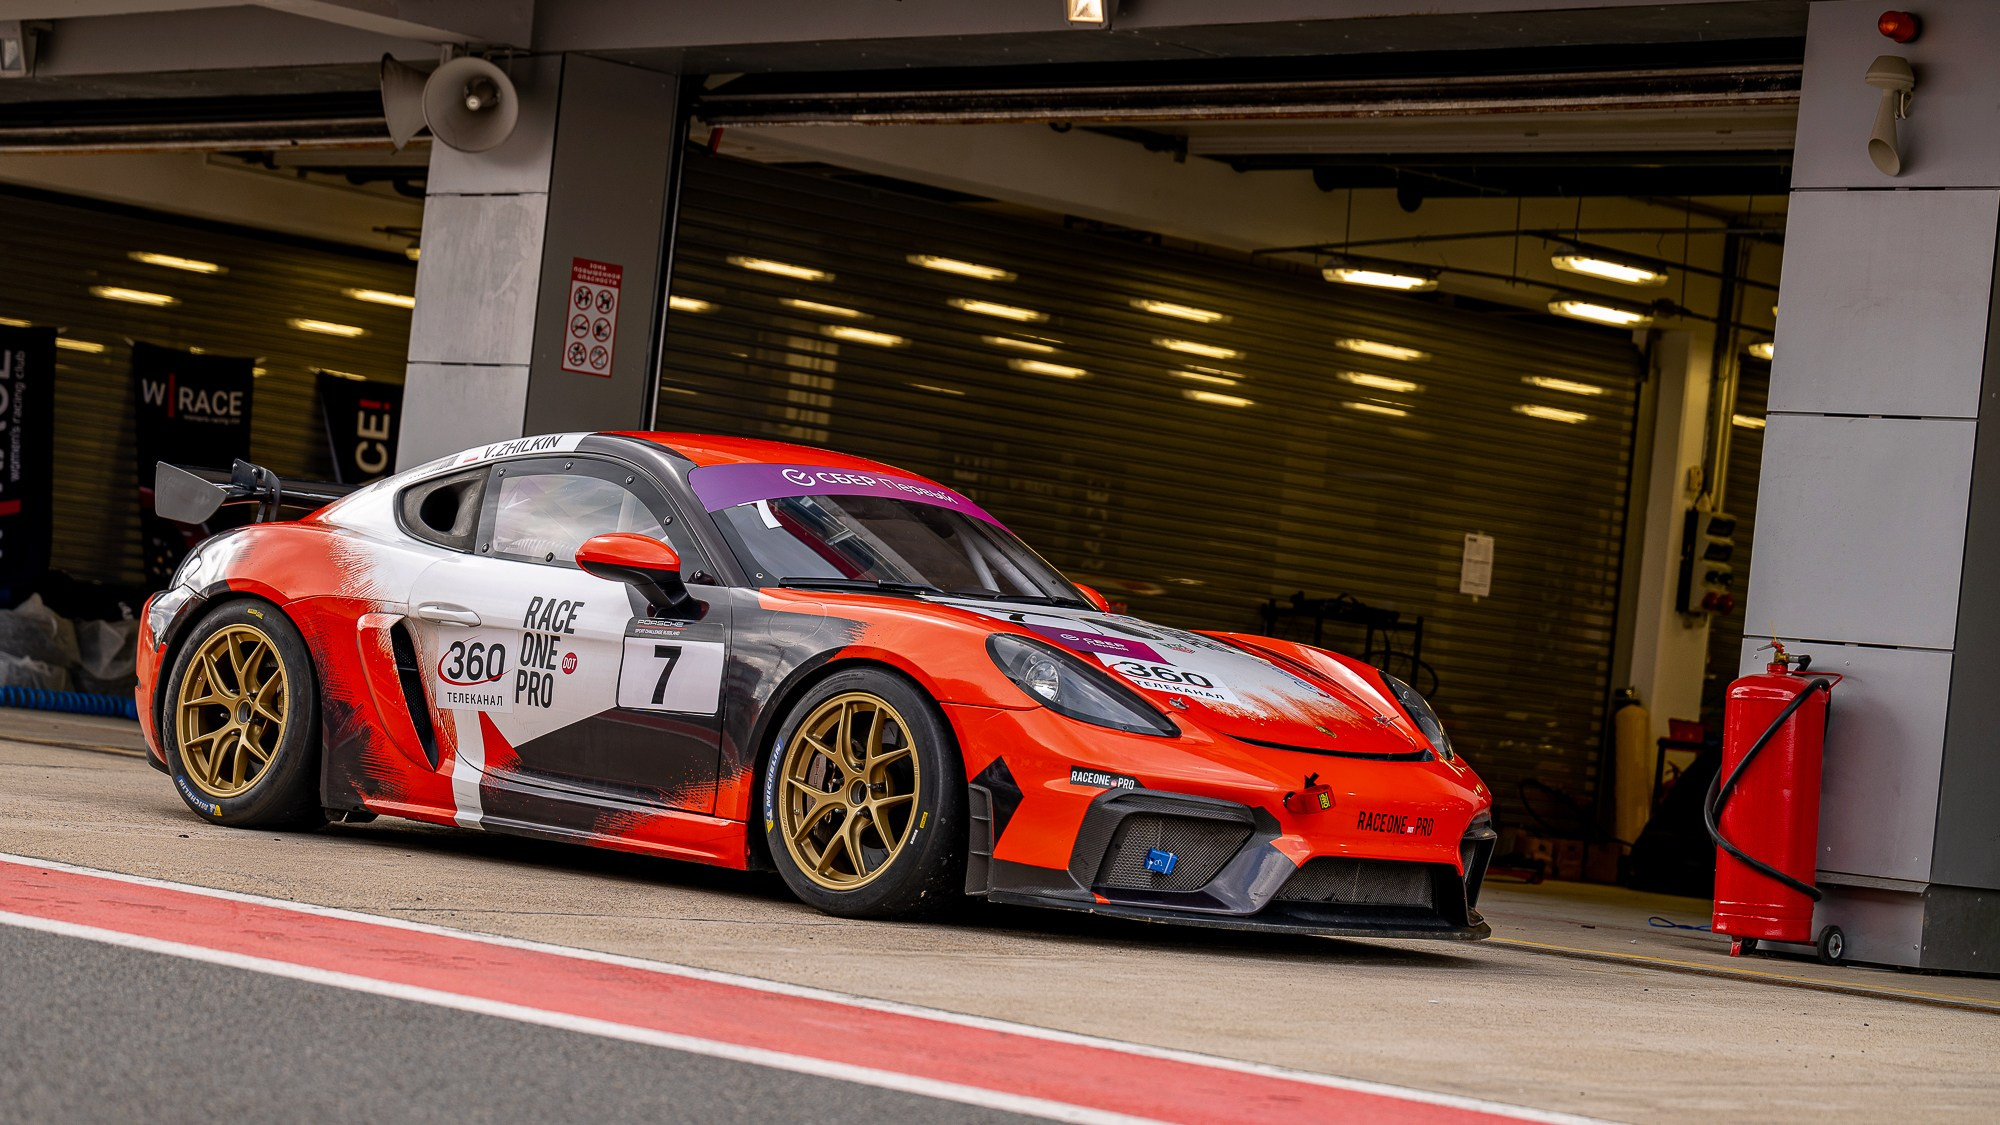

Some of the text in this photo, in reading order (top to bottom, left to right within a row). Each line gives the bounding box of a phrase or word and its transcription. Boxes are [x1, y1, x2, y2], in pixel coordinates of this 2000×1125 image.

[178, 386, 243, 416] RACE
[484, 435, 563, 459] V.ZHILKIN
[815, 472, 877, 487] СБЕР
[523, 595, 586, 635] RACE
[637, 619, 684, 628] PORSCHE
[447, 641, 506, 683] 360
[519, 631, 561, 671] ONE
[562, 657, 577, 670] DOT
[515, 668, 554, 709] PRO
[651, 644, 682, 705] 7
[1119, 661, 1214, 689] 360
[447, 692, 503, 707] ТЕЛЕКАНАЛ
[1136, 679, 1225, 701] ТЕЛЕКАНАЛ
[766, 742, 782, 808] MICHELIN
[1117, 777, 1135, 790] PRO
[178, 778, 209, 811] MICHELIN
[1414, 817, 1434, 836] PRO
